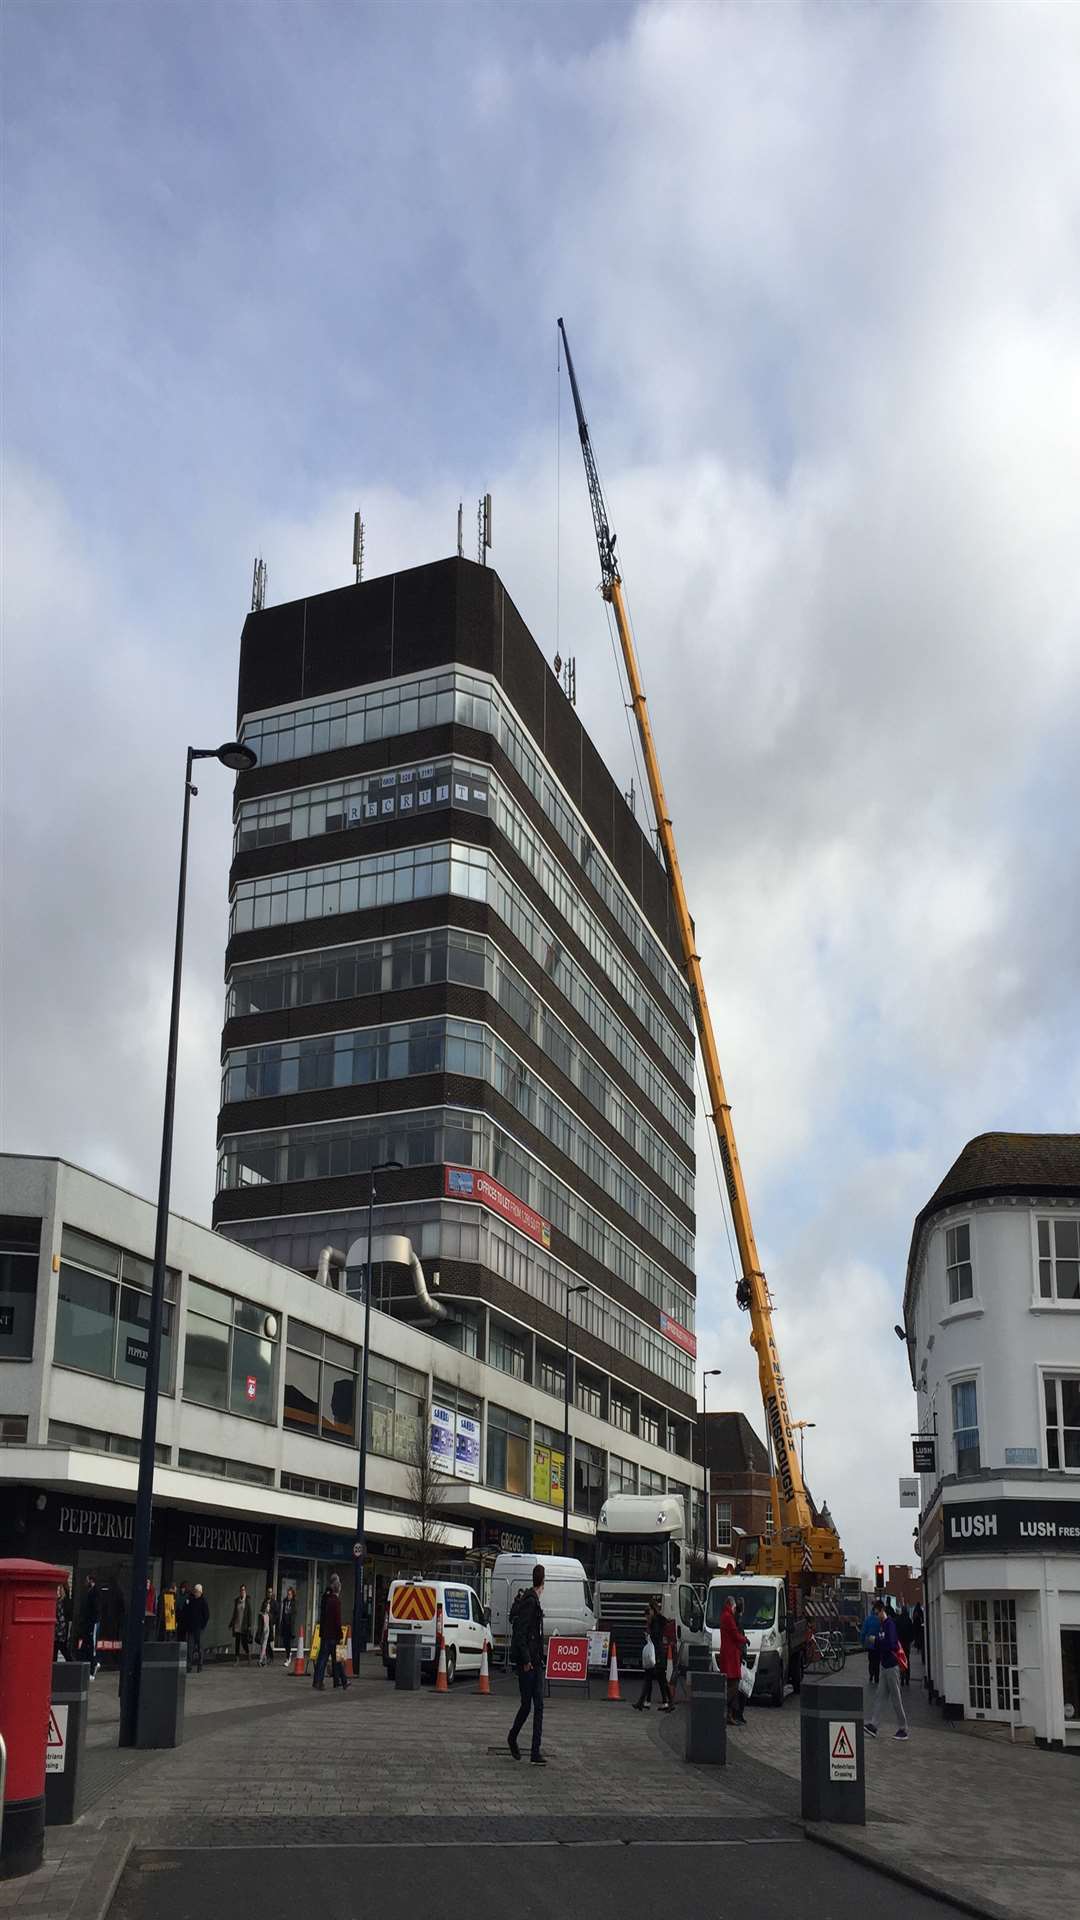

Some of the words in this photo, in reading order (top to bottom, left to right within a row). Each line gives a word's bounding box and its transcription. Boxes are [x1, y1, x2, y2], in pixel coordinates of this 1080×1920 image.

[351, 786, 466, 818] RECRUIT
[477, 1179, 497, 1201] OFFICES
[768, 1395, 795, 1503] AINSCOUGH
[915, 1447, 933, 1455] LUSH
[58, 1506, 136, 1541] PEPPERMI
[951, 1514, 998, 1538] LUSH
[1020, 1521, 1056, 1537] LUSH
[187, 1524, 264, 1554] PEPPERMINT
[501, 1532, 525, 1553] GREGGS
[557, 1645, 579, 1656] ROAD
[552, 1661, 582, 1672] CLOSED
